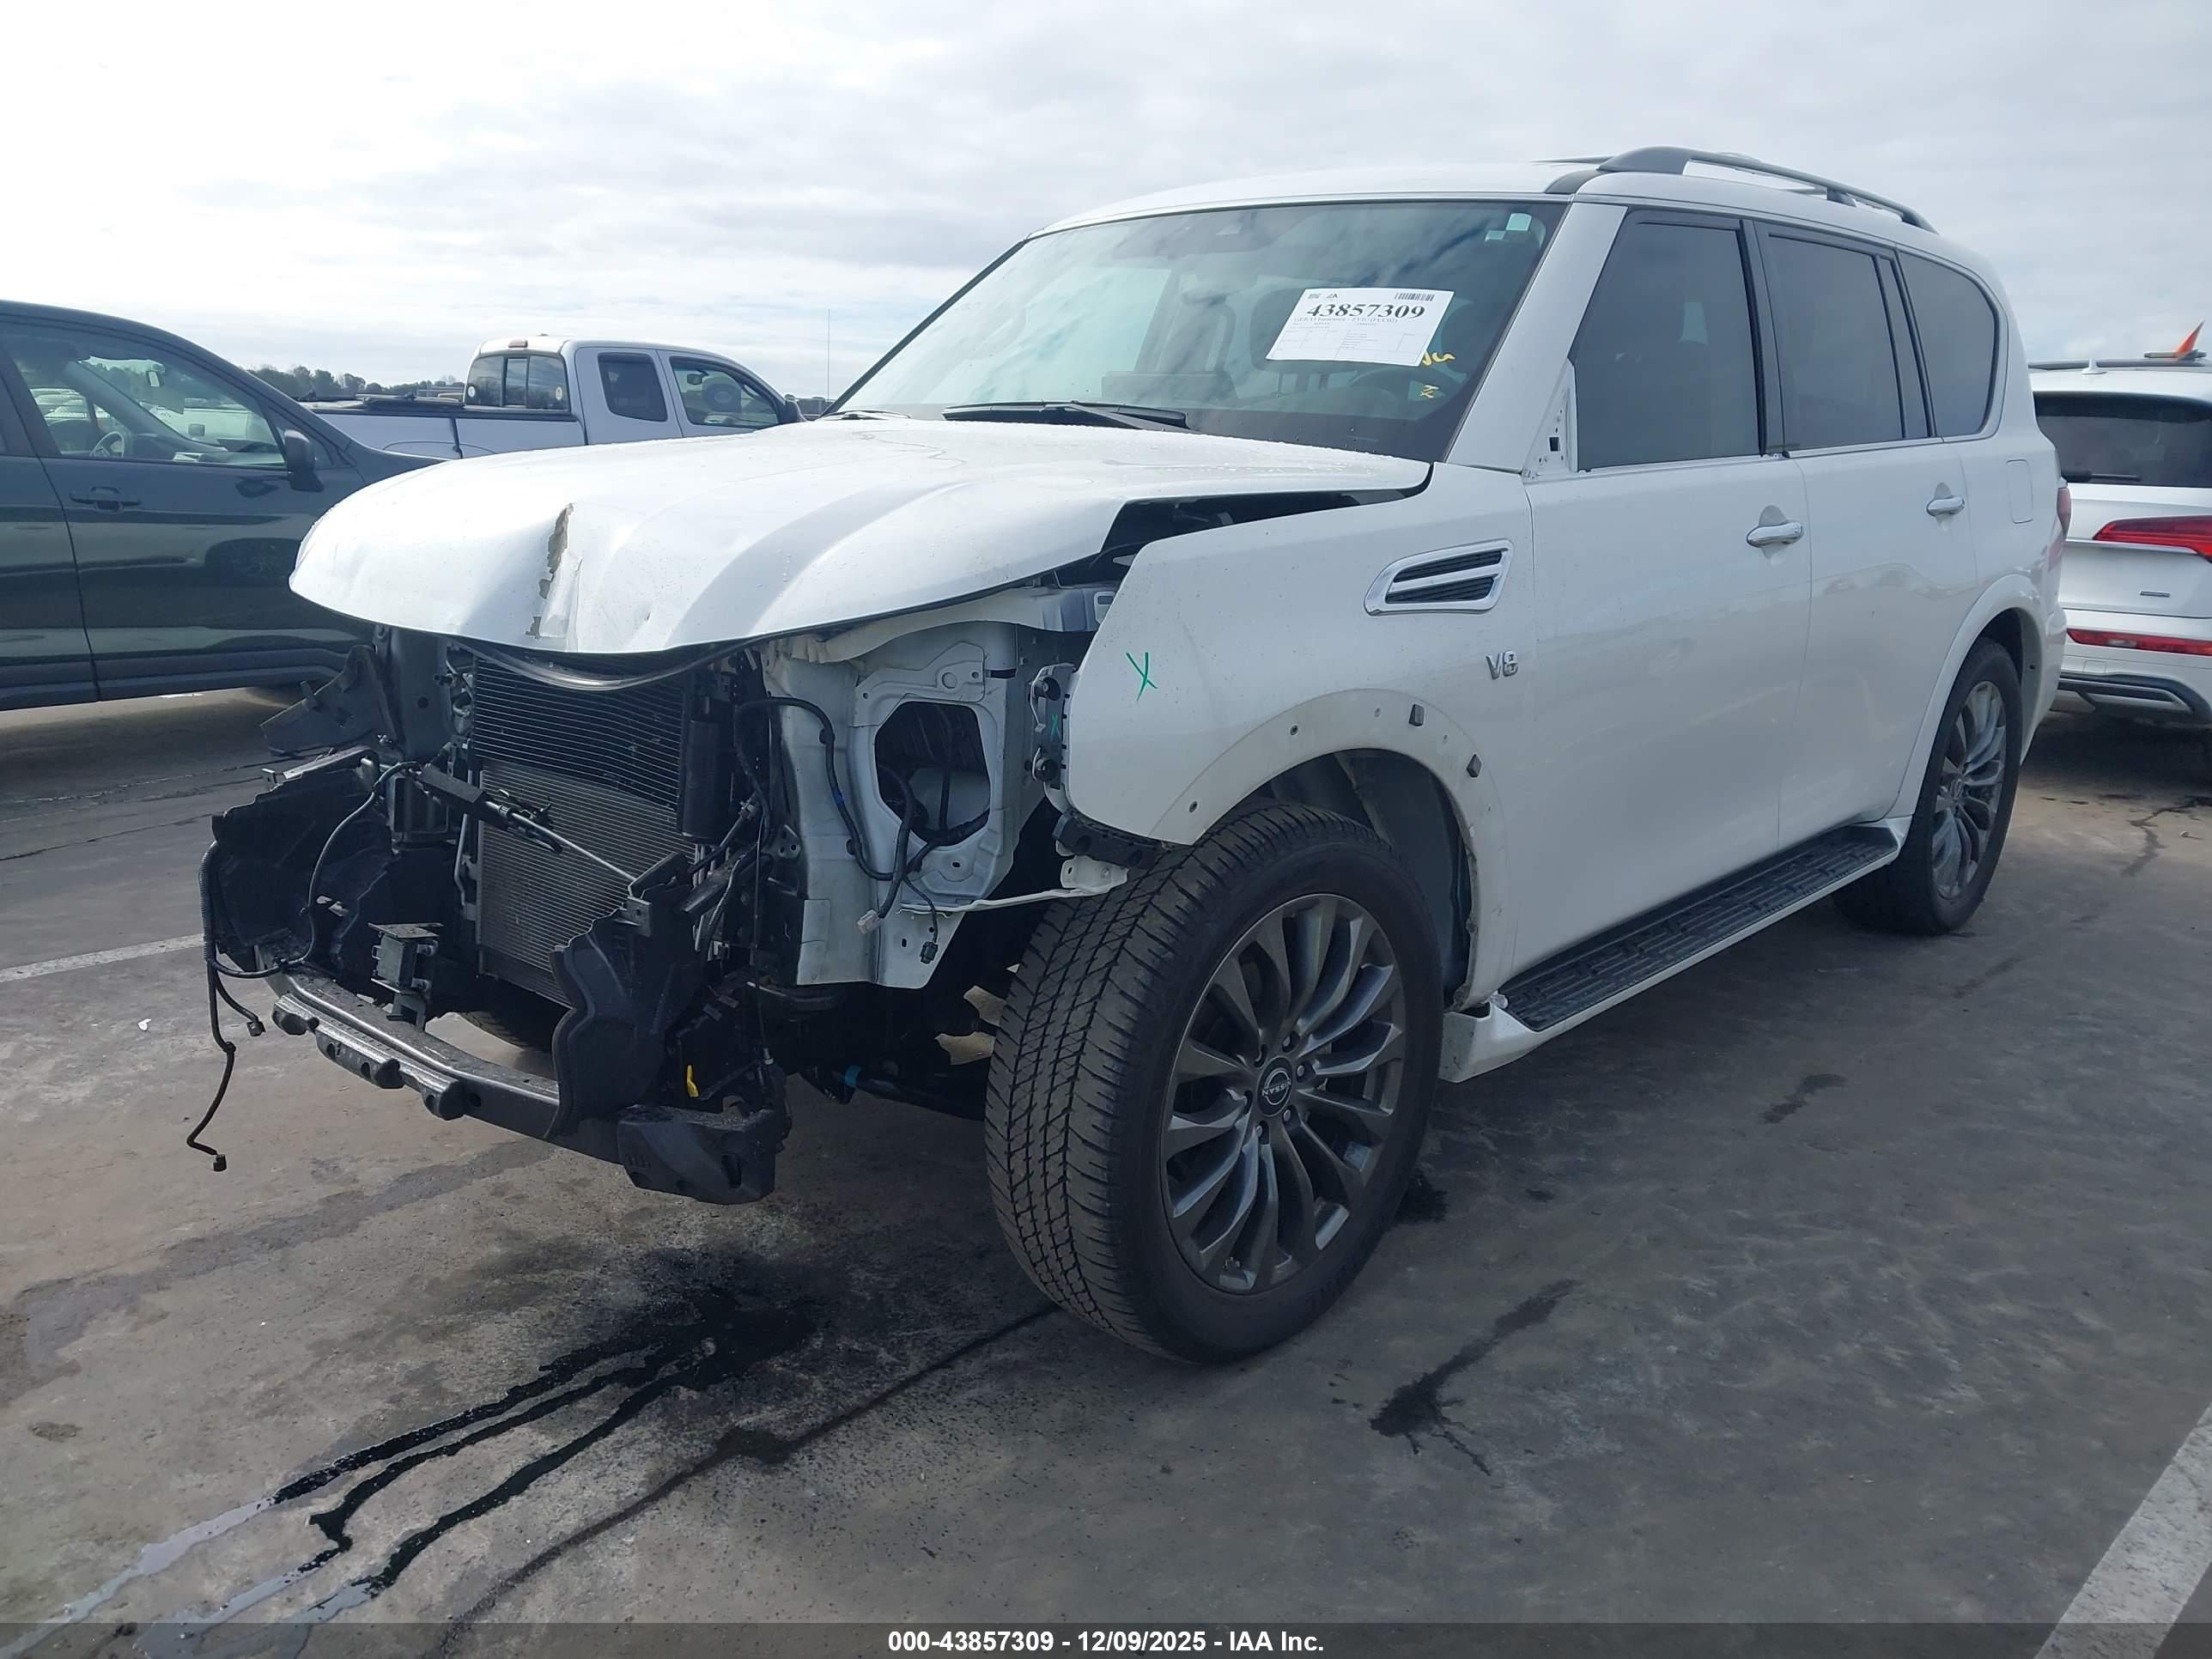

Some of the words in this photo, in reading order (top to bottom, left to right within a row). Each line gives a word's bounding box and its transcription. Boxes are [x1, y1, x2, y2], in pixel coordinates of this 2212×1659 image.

[1307, 303, 1425, 319] 43857309
[1486, 650, 1518, 680] V8
[1262, 1079, 1291, 1096] NISSAN
